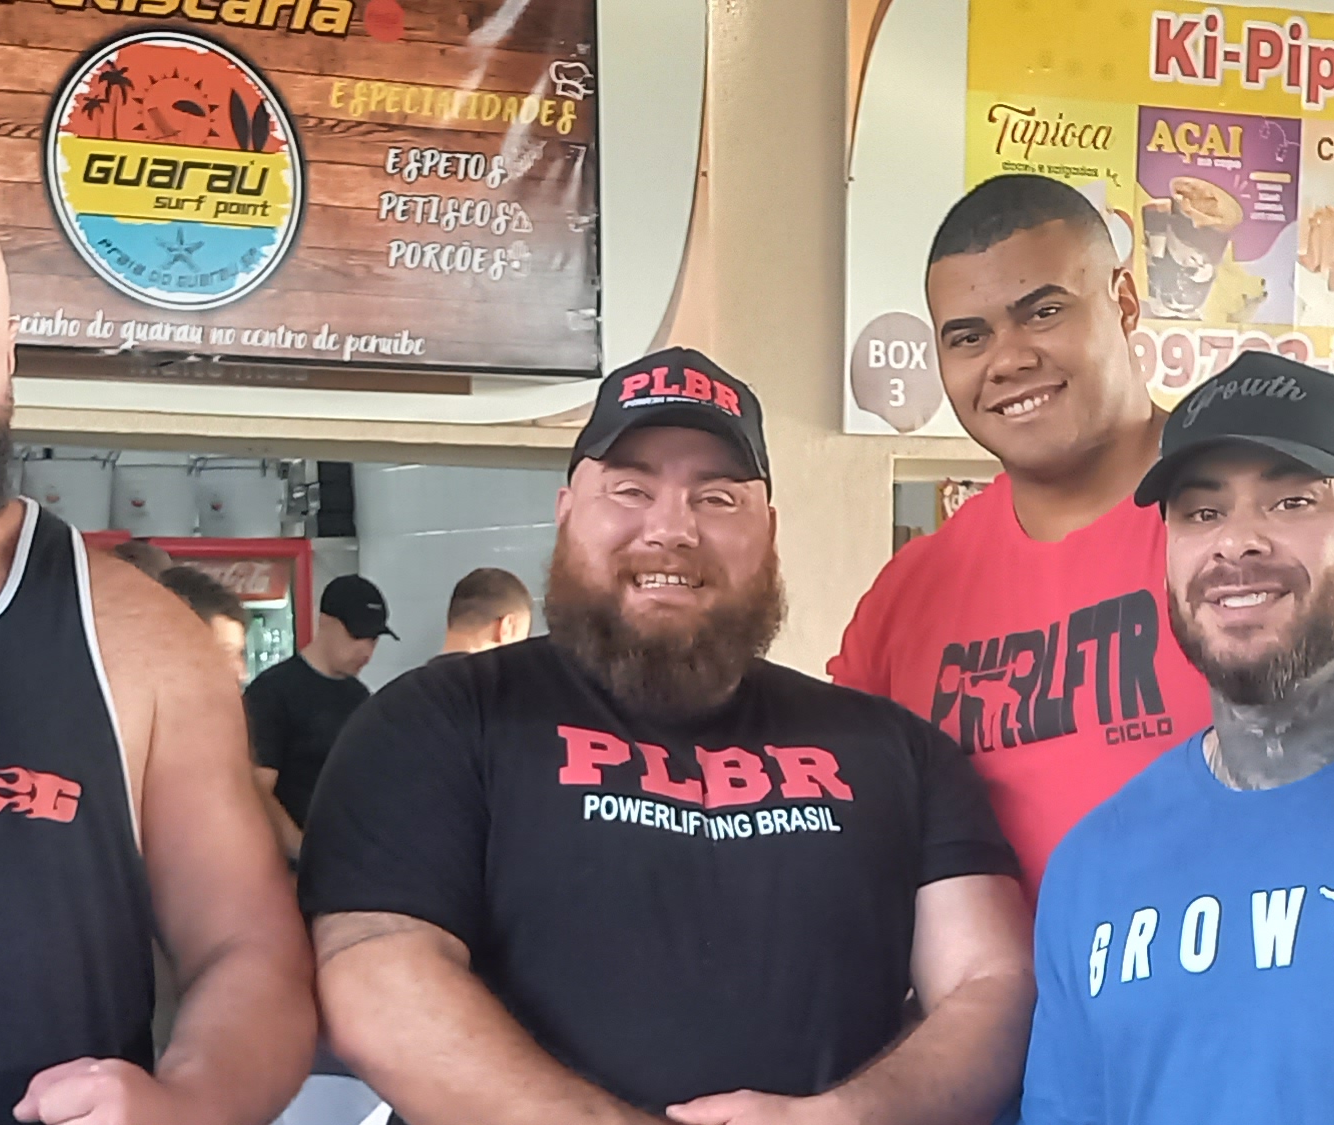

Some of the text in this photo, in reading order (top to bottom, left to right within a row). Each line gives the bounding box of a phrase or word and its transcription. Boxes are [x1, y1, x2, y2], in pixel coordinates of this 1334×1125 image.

[330, 79, 577, 135] ESPECIALIDADES
[988, 103, 1113, 160] Tapioca
[384, 147, 508, 189] ESPETOS
[153, 194, 272, 218] surf point
[378, 192, 516, 235] PETISCOS
[387, 239, 510, 281] PORÇÕES
[86, 309, 115, 339] do
[209, 326, 236, 345] no
[312, 323, 341, 351] de
[869, 339, 928, 370] BOX
[618, 366, 742, 417] PLBR
[889, 377, 906, 407] 3
[1105, 717, 1174, 746] CICLO
[556, 724, 855, 810] PLBR
[583, 793, 842, 841] POWERLIFTING BRASIL
